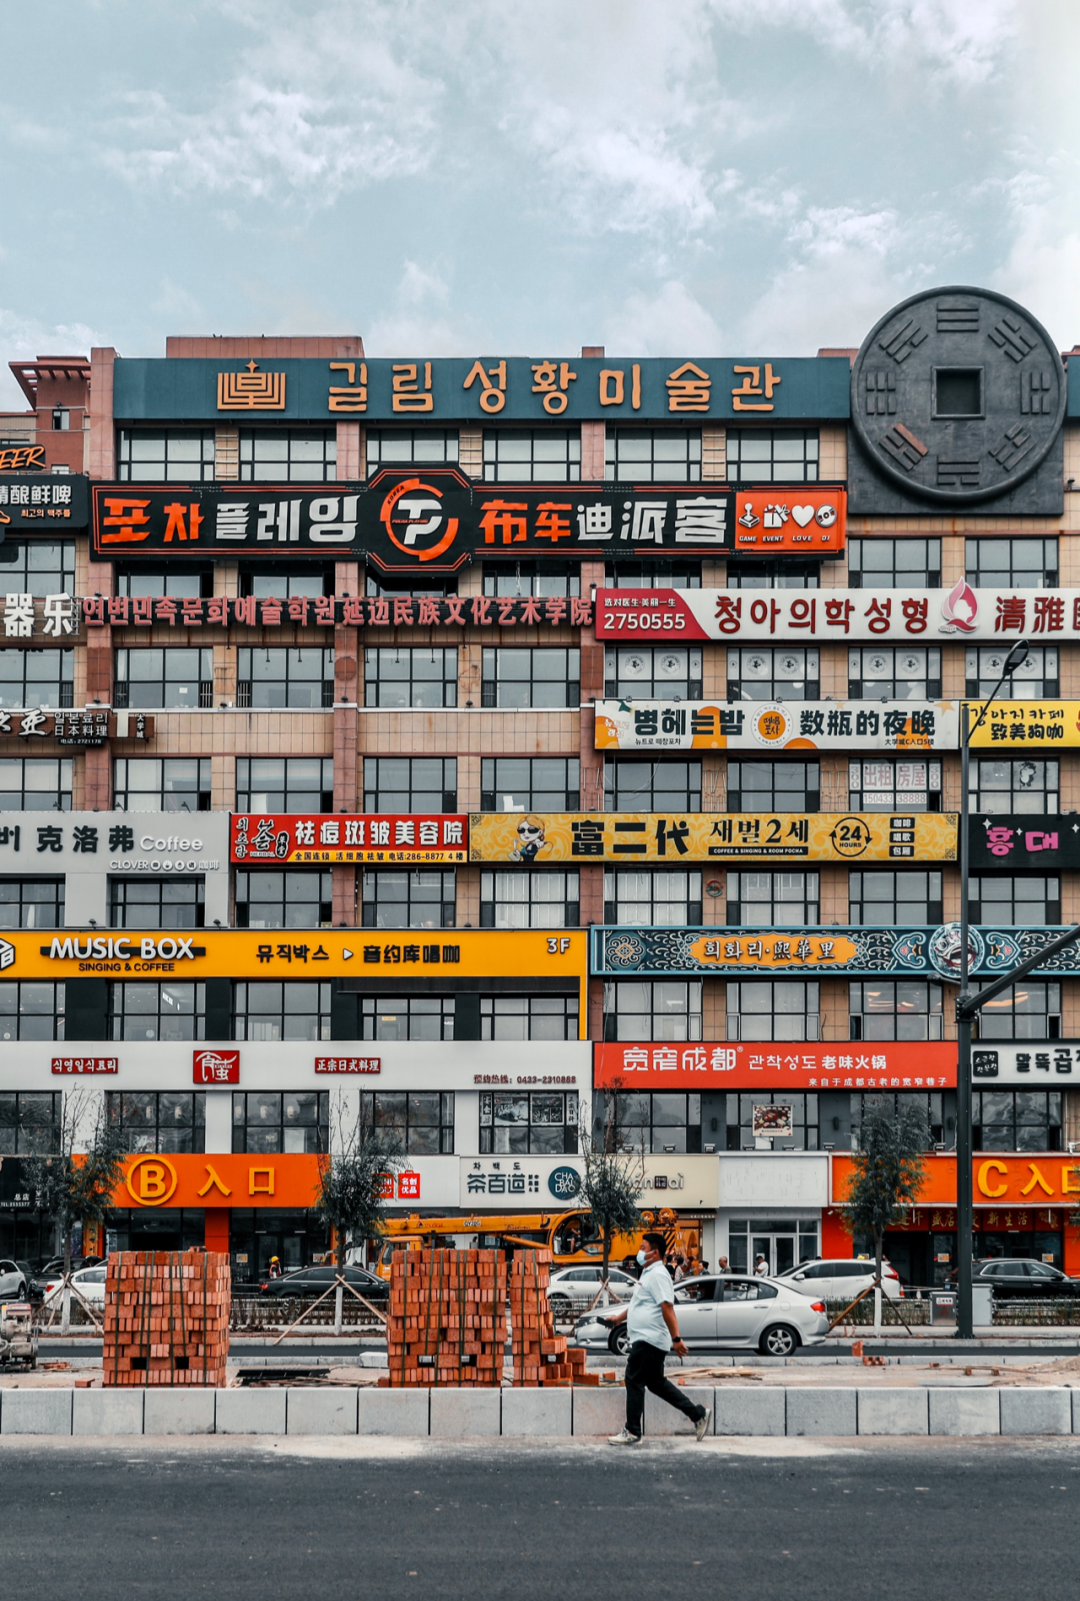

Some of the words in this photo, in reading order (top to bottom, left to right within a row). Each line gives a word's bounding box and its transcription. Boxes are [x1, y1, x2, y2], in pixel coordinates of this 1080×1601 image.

[328, 360, 782, 414] 길림성황미술관
[82, 595, 335, 627] 연변민족문화예술학원
[342, 595, 593, 627] 延边民族文化艺术学院
[603, 612, 686, 630] 2750555
[714, 595, 929, 634] 청아의학성형
[54, 712, 108, 724] 일본료리
[136, 713, 144, 739] 大学城
[799, 709, 936, 737] 数瓶的夜晚
[54, 725, 108, 737] 日本料理
[991, 723, 1064, 741] 致美狗咖
[865, 764, 926, 787] 出租房屋
[37, 825, 135, 852] 克洛弗
[140, 835, 203, 851] Coffee
[295, 820, 463, 846] 祛痘斑皱美容院
[571, 820, 689, 856] 富二代
[839, 826, 862, 841] 24
[986, 826, 1059, 857] 홍대
[110, 860, 148, 870] CLOVER
[295, 852, 330, 860] 全国连锁
[50, 937, 131, 960] MUSIC
[140, 937, 195, 960] BOX
[256, 944, 330, 964] 뮤직박스
[546, 938, 571, 954] 3F
[78, 963, 121, 972] SINGING
[124, 963, 132, 972] &
[134, 963, 175, 972] COFFEE
[316, 1059, 380, 1072] 正宗日式料理
[749, 1055, 817, 1071] 관착성도
[821, 1055, 887, 1070] 老味火锅
[1016, 1048, 1080, 1073] 말뚝곱
[809, 1077, 948, 1087] 来自于成都古老的宽窄巷子
[473, 1162, 521, 1170] 차백도
[139, 1165, 166, 1198] B
[198, 1164, 275, 1197] 入口
[467, 1173, 525, 1193] 茶百道
[554, 1173, 574, 1181] CHA
[978, 1160, 1007, 1197] C
[1020, 1163, 1080, 1196] 入口
[555, 1184, 576, 1193] DAO
